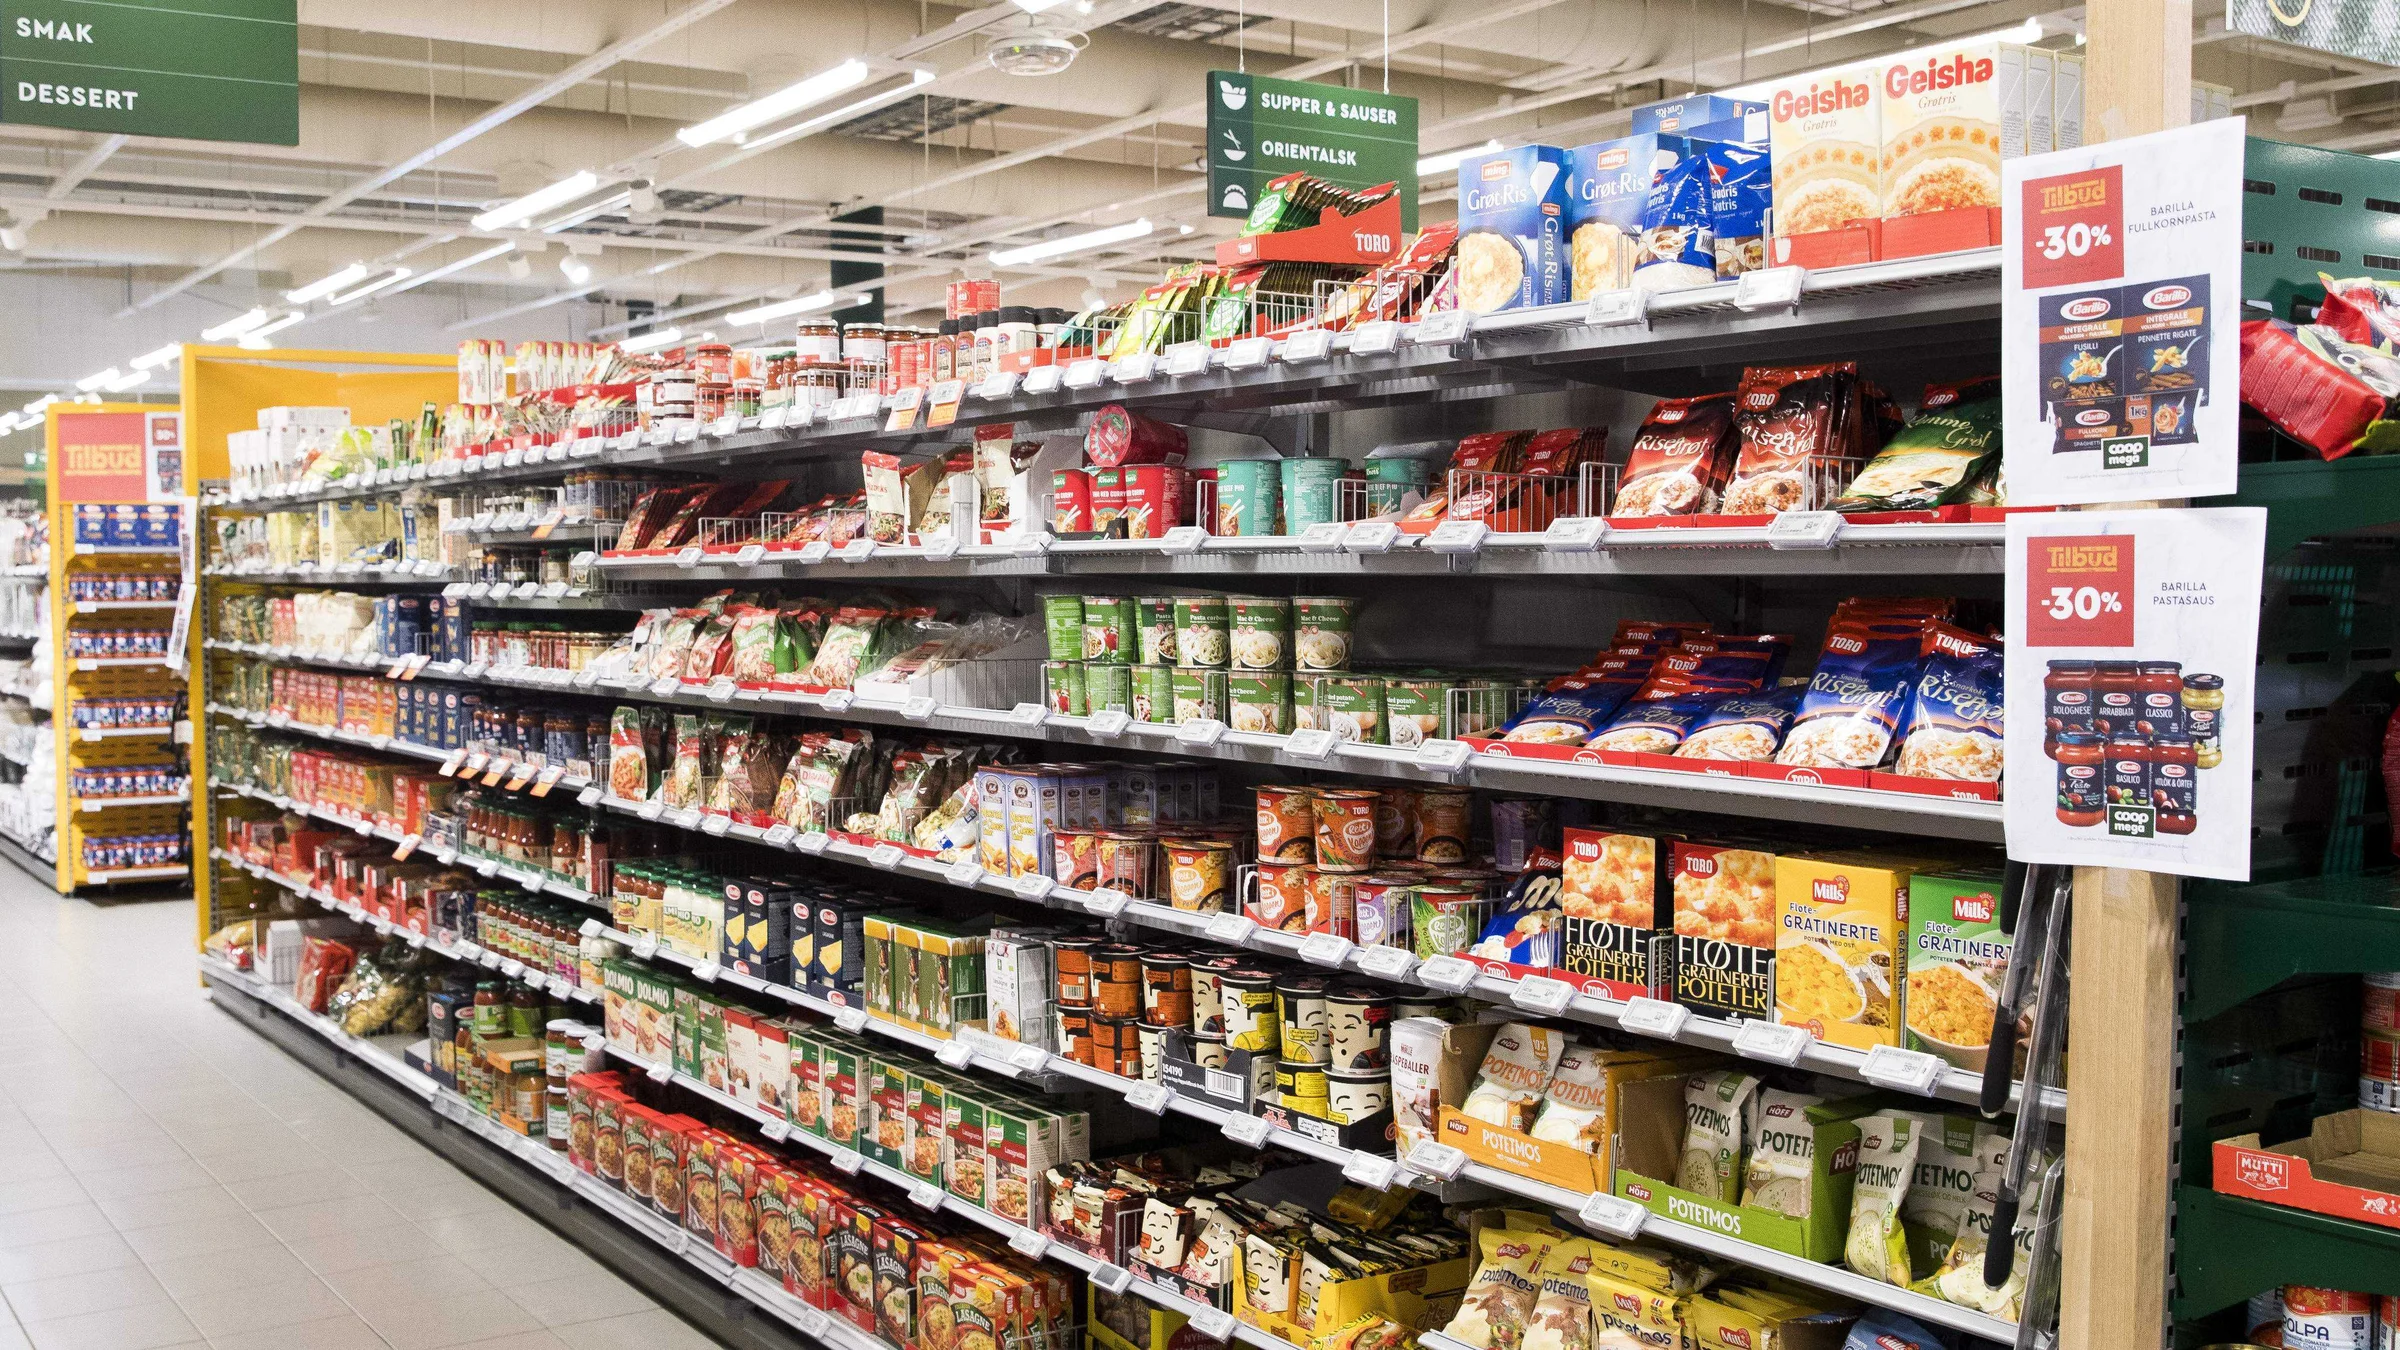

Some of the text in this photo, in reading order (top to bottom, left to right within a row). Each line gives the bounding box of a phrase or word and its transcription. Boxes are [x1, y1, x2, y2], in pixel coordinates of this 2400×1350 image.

[17, 17, 93, 44] SMAK
[1885, 54, 1993, 100] Geisha
[18, 82, 138, 111] DESSERT
[1773, 80, 1870, 123] Geisha
[1261, 93, 1397, 125] SUPPER & SAUSER
[1261, 140, 1357, 167] ORIENTALSK
[2041, 179, 2106, 213] Tilbud
[2150, 200, 2194, 217] BARILLA
[2128, 210, 2217, 234] FULLKORNPASTA
[1355, 233, 1391, 253] TORO
[2036, 222, 2112, 260] -30%
[2071, 302, 2108, 316] Barilla
[2146, 312, 2188, 324] INTEGRALE
[2064, 322, 2108, 334] INTEGRALE
[2138, 328, 2197, 344] PENNETTE RIGATE
[2074, 343, 2099, 351] FUSILLI
[2108, 442, 2144, 455] coop
[64, 444, 142, 477] Tilbud
[2108, 453, 2140, 467] mega
[2047, 546, 2118, 572] Tilbud
[2161, 582, 2207, 591] BARILLA
[2041, 586, 2122, 620] -30%
[2153, 595, 2215, 605] PASTASAUS
[1829, 636, 1863, 653] TORO
[1936, 633, 1972, 654] TORO
[1668, 658, 1698, 671] TORO
[2053, 706, 2091, 715] BOLOGNESE
[2099, 707, 2134, 716] ARRABBIATA
[2146, 708, 2173, 718] CLASSICO
[2116, 774, 2140, 784] BASILICO
[1352, 806, 1369, 815] TORO
[2114, 810, 2149, 823] coop
[2115, 823, 2145, 834] mega
[1178, 855, 1193, 865] TORO
[1573, 841, 1598, 858] TORO
[1685, 857, 1713, 873] TORO
[1814, 881, 1845, 902] Mills
[1954, 900, 1991, 920] Mills
[1566, 916, 1647, 956] FLØTE
[1784, 914, 1879, 942] GRATINERTE
[1566, 943, 1647, 970] GRATINERTE
[1679, 935, 1768, 977] FLØTE
[1566, 954, 1646, 986] POTETER
[1678, 963, 1768, 991] GRATINERTE
[604, 967, 634, 996] DOLMIO
[637, 980, 670, 1008] DOLMIO
[1678, 975, 1768, 1012] POTETER
[1392, 1055, 1430, 1076] ASPEBALLER
[1483, 1054, 1547, 1090] POTETMOS
[1550, 1076, 1607, 1105] POTETMO
[1686, 1103, 1731, 1137] OTETMOS
[1768, 1106, 1792, 1117] HOFF
[1449, 1121, 1468, 1134] HOFF
[1482, 1129, 1541, 1163] POTETMOS
[2241, 1156, 2283, 1175] MUTTI
[1629, 1186, 1652, 1200] HOFF
[1668, 1195, 1742, 1235] POTETMOS
[876, 1256, 907, 1280] LASAGNE
[955, 1307, 992, 1333] LASAGNE
